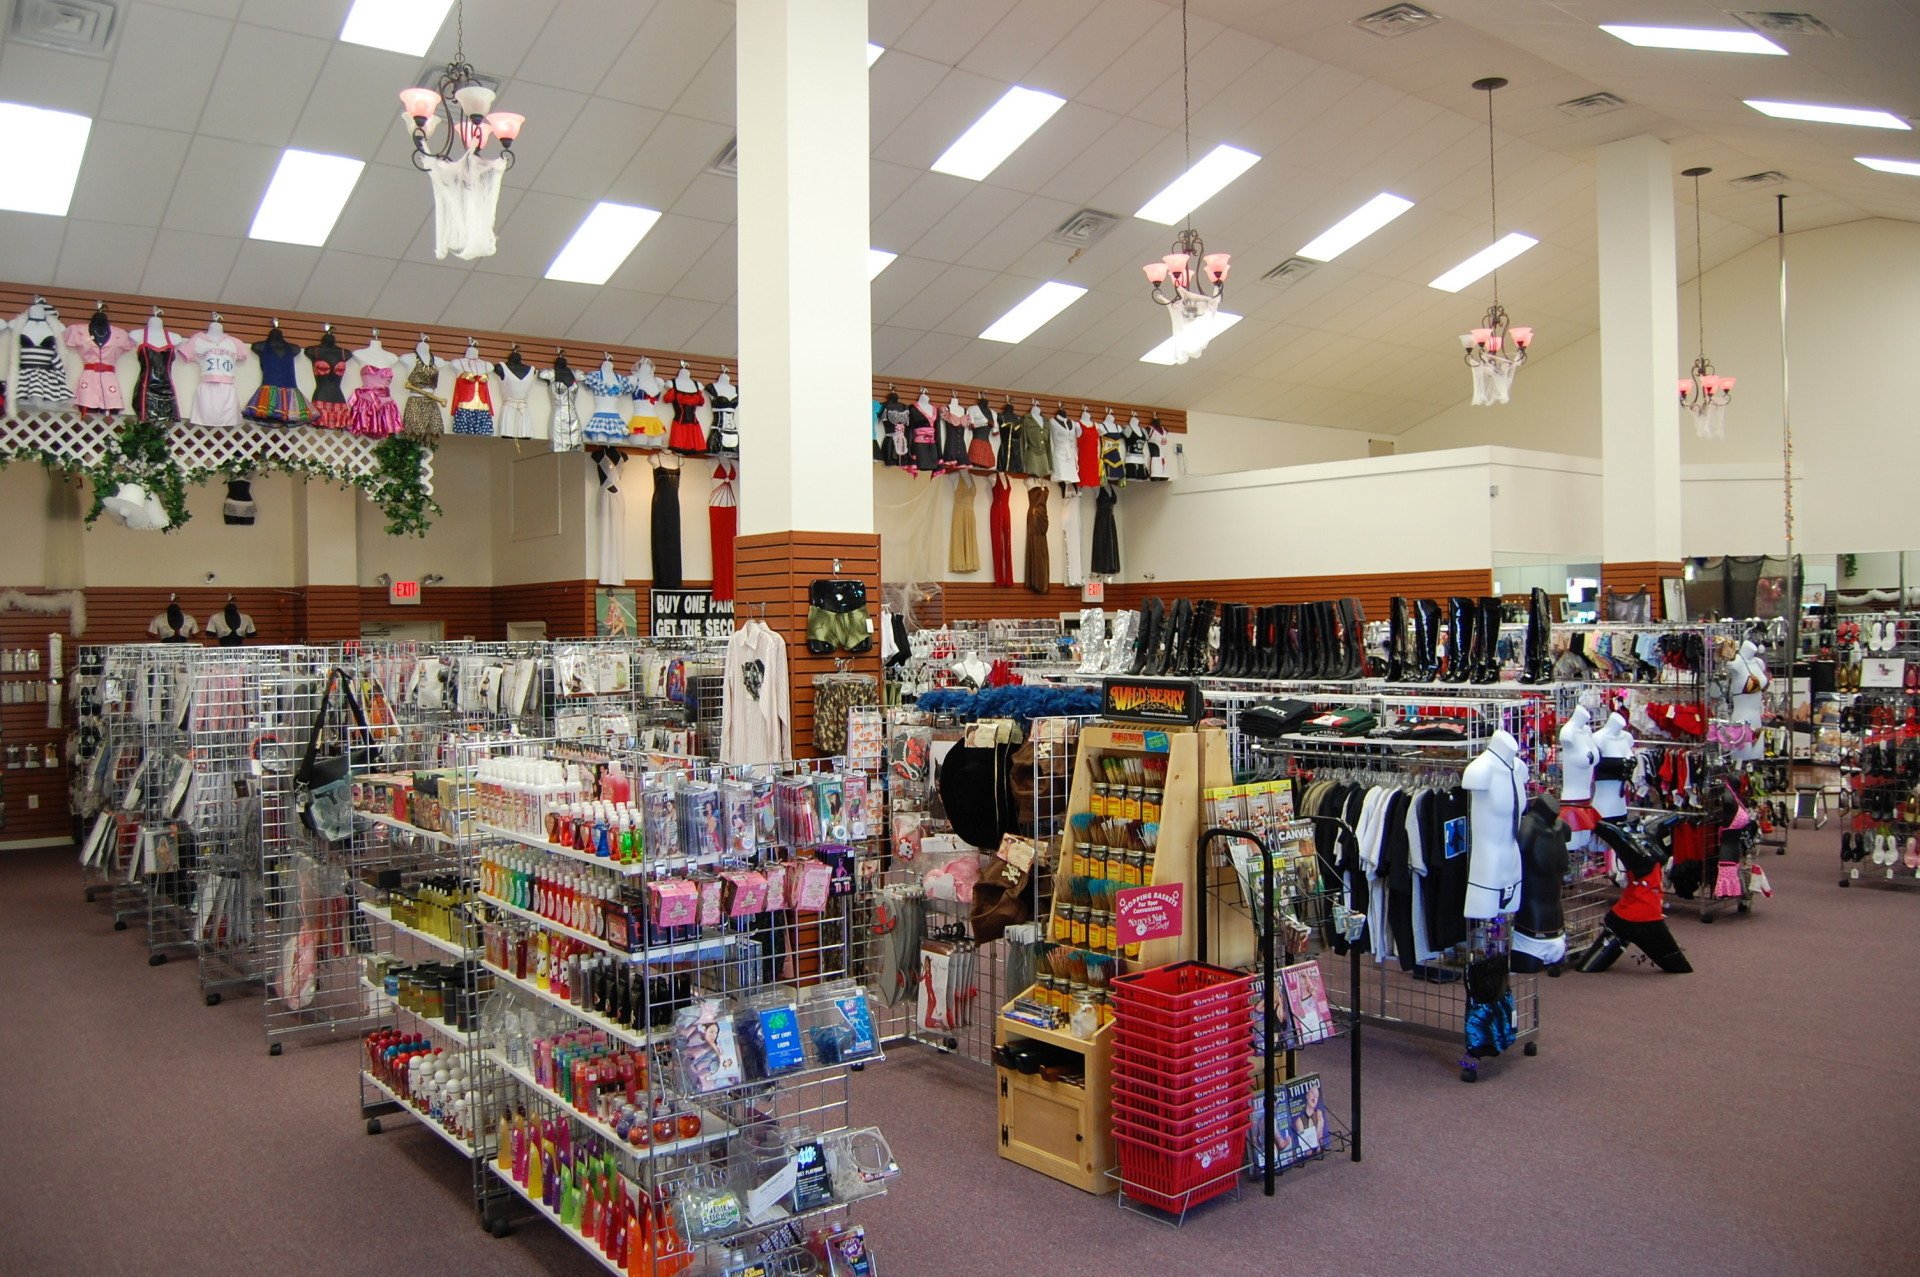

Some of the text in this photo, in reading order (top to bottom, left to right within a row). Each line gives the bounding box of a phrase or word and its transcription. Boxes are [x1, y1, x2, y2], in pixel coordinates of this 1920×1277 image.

[396, 582, 416, 597] EXIT
[656, 595, 681, 614] BUY
[684, 595, 706, 614] ONE
[655, 618, 677, 637] GET
[680, 618, 702, 637] THE
[1147, 688, 1185, 713] BERRY
[1278, 827, 1314, 842] CANVAS
[1120, 891, 1179, 916] SHOPPING BASKETS
[1288, 1078, 1321, 1098] TATTOO
